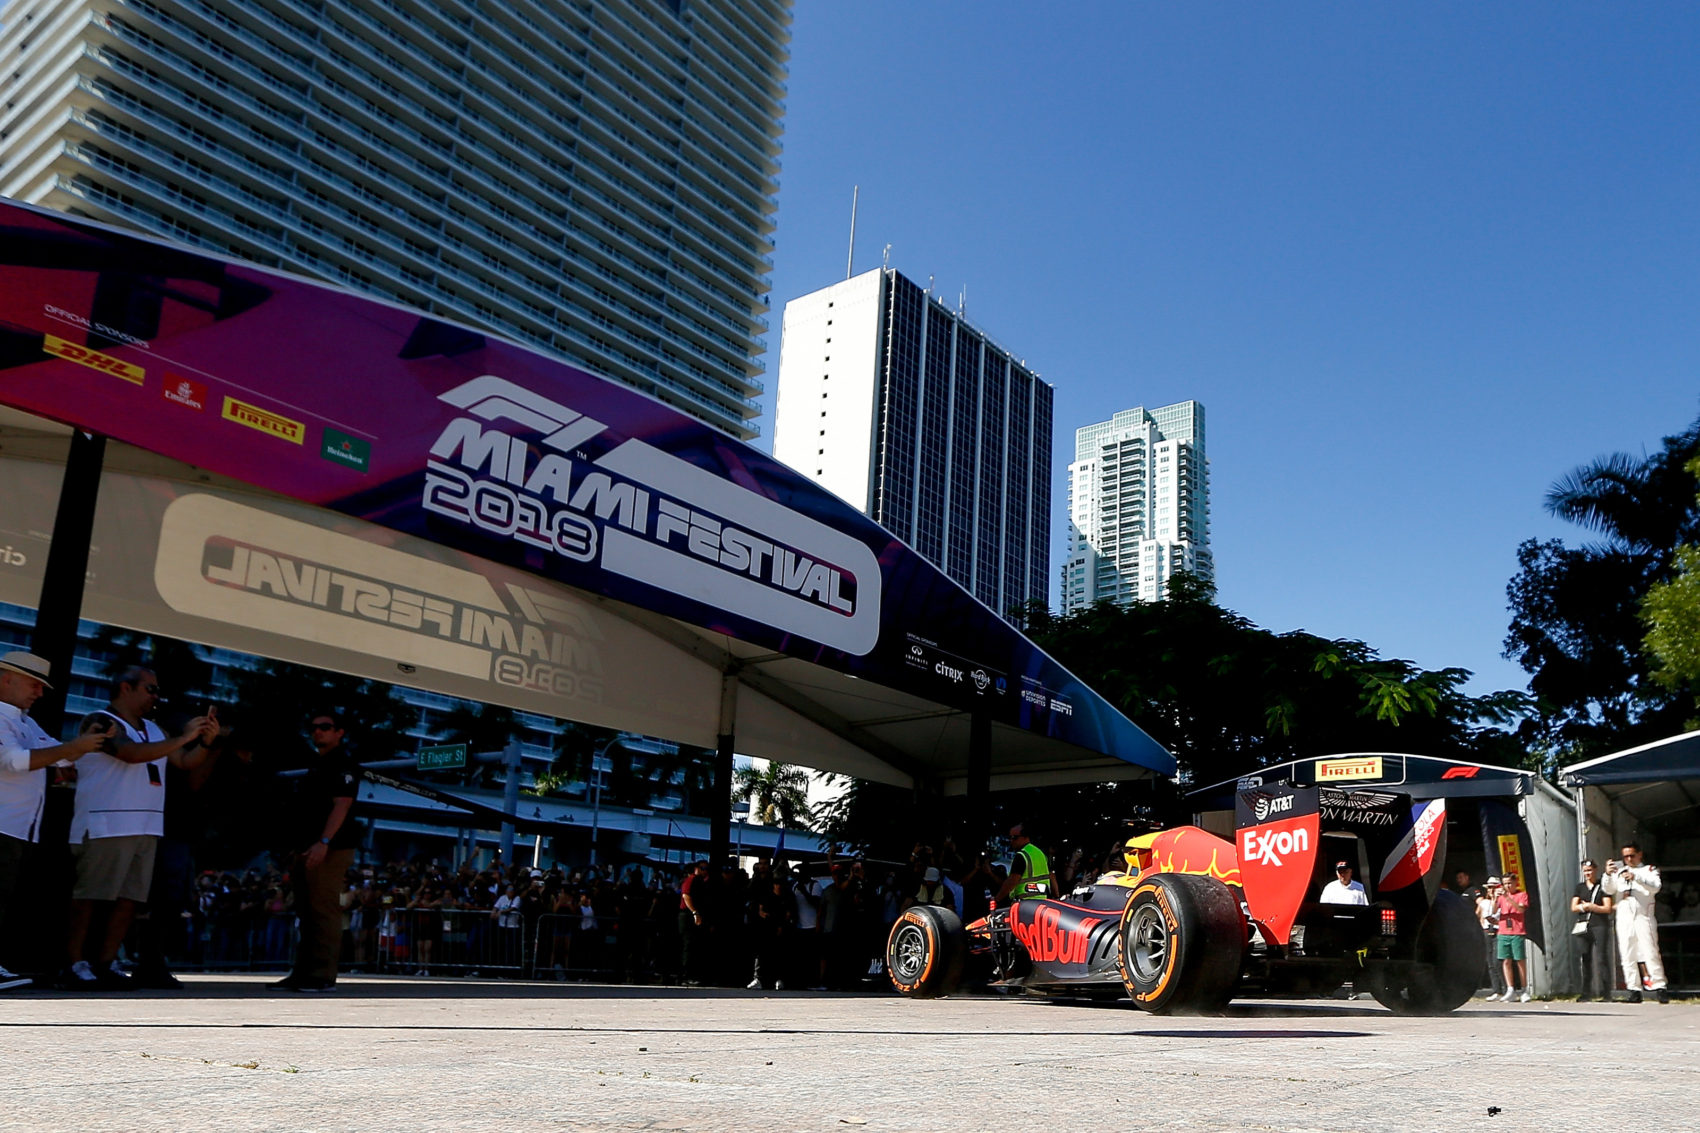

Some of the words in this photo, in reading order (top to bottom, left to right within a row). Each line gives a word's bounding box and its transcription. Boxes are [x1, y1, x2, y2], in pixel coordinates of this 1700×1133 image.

[58, 343, 130, 377] DHL
[164, 389, 203, 410] Emirates
[230, 401, 298, 438] PIRELLI
[327, 445, 363, 464] Heineken
[422, 472, 597, 563] 2018
[429, 417, 650, 534] MIAMI
[656, 497, 853, 614] FESTIVAL
[1050, 698, 1073, 716] ESPN
[420, 752, 425, 764] E
[427, 751, 453, 766] Flagler
[455, 748, 464, 761] St
[1321, 760, 1375, 777] PIRELLI
[1268, 795, 1295, 815] AT&T
[1327, 791, 1345, 799] ASTON
[1348, 794, 1369, 802] MARTIN
[1342, 808, 1398, 825] MARTIN
[1243, 828, 1308, 867] Exxon
[1503, 842, 1521, 889] ELLI
[1154, 886, 1178, 932] PIRELLI
[904, 912, 926, 928] PIRELLI
